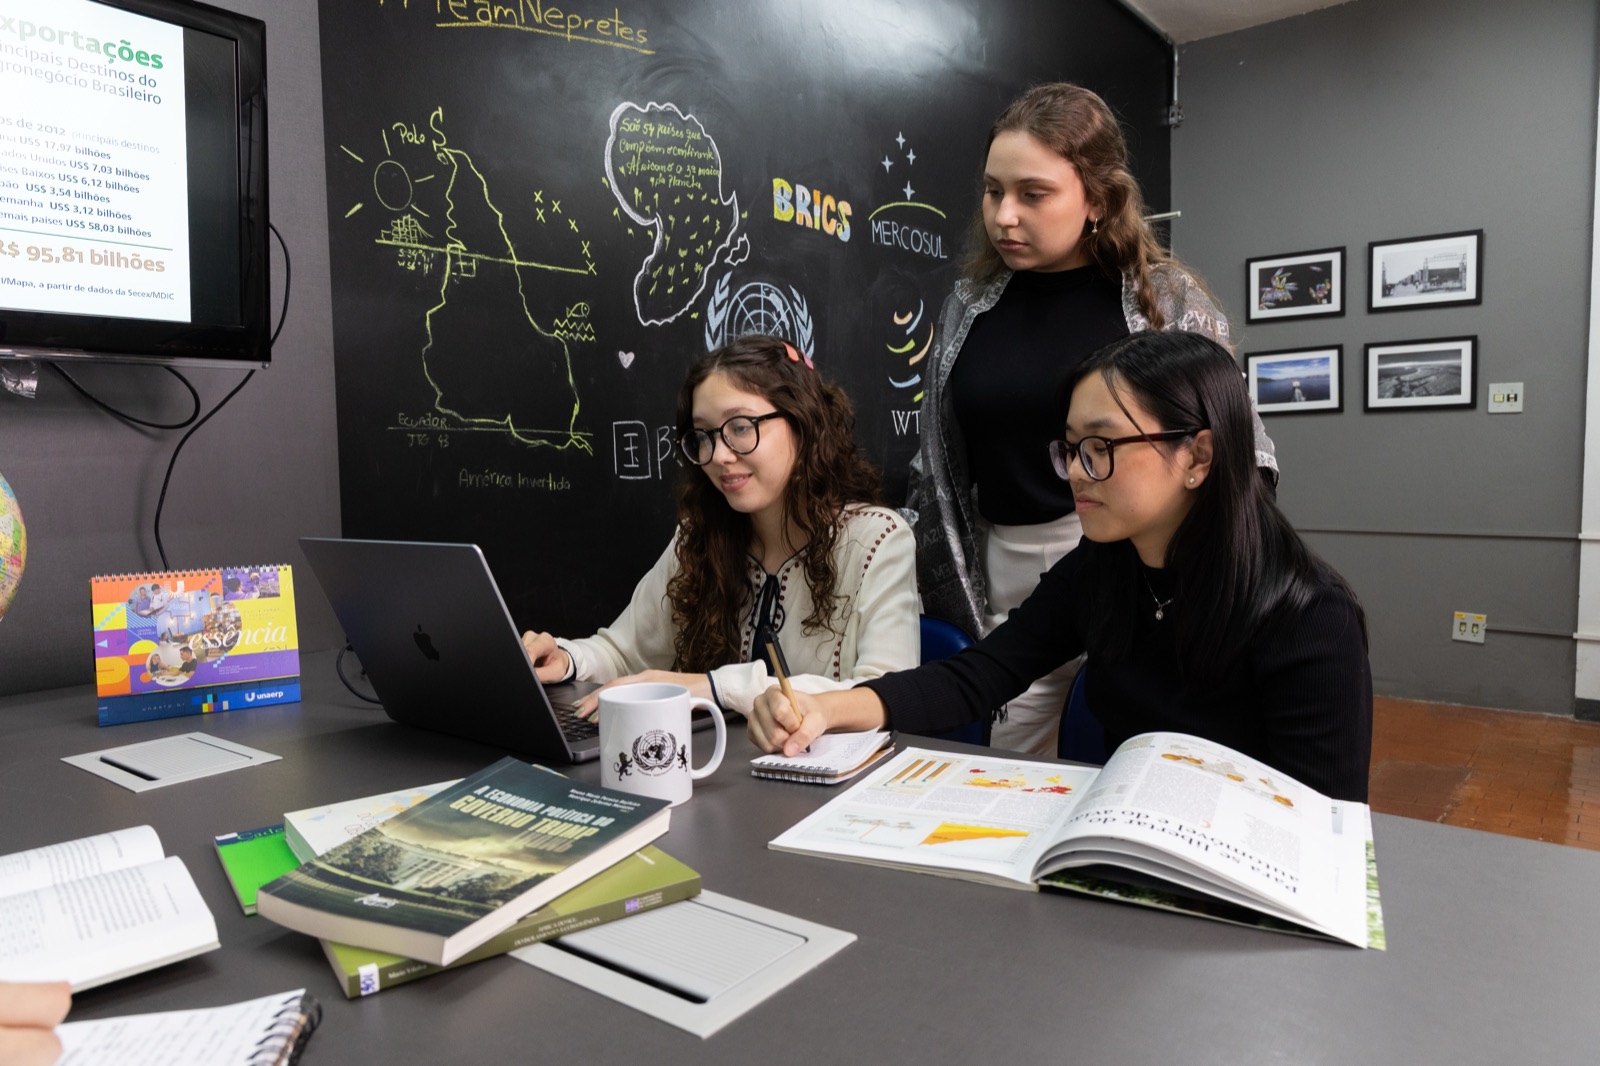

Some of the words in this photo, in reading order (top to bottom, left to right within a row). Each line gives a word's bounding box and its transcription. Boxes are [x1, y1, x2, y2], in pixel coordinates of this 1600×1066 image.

[68, 57, 135, 83] Destinos
[138, 74, 157, 88] do
[92, 79, 162, 104] Brasileiro
[16, 118, 33, 130] de
[37, 123, 66, 136] 2012
[71, 131, 119, 148] principais
[120, 139, 160, 154] destinos
[30, 153, 67, 168] Unidos
[92, 164, 113, 175] 7,03
[115, 167, 150, 181] bilhões
[75, 146, 111, 160] bilhões
[21, 167, 56, 181] Baixos
[81, 177, 103, 188] 6,12
[105, 180, 140, 194] bilhões
[49, 187, 72, 198] 3,54
[74, 190, 111, 203] bilhões
[73, 205, 94, 216] 3,12
[96, 208, 132, 221] bilhões
[773, 177, 852, 243] BRICS
[88, 222, 115, 233] 58,03
[117, 225, 152, 238] bilhões
[871, 219, 948, 259] MERCOSUL
[26, 245, 84, 264] 95,81
[90, 249, 166, 273] bilhões
[47, 281, 72, 294] partir
[74, 284, 86, 293] de
[87, 285, 114, 296] dados
[115, 287, 126, 296] da
[127, 289, 175, 301] Secex/MDIC
[458, 467, 513, 488] América
[517, 472, 572, 491] Invertida
[189, 621, 288, 651] essência
[449, 794, 537, 828] GOVERNO
[528, 817, 600, 840] TRUMP
[473, 785, 490, 795] A
[484, 788, 545, 813] ECONOMIA
[540, 804, 596, 824] POLÍTICA
[591, 816, 615, 827] DO
